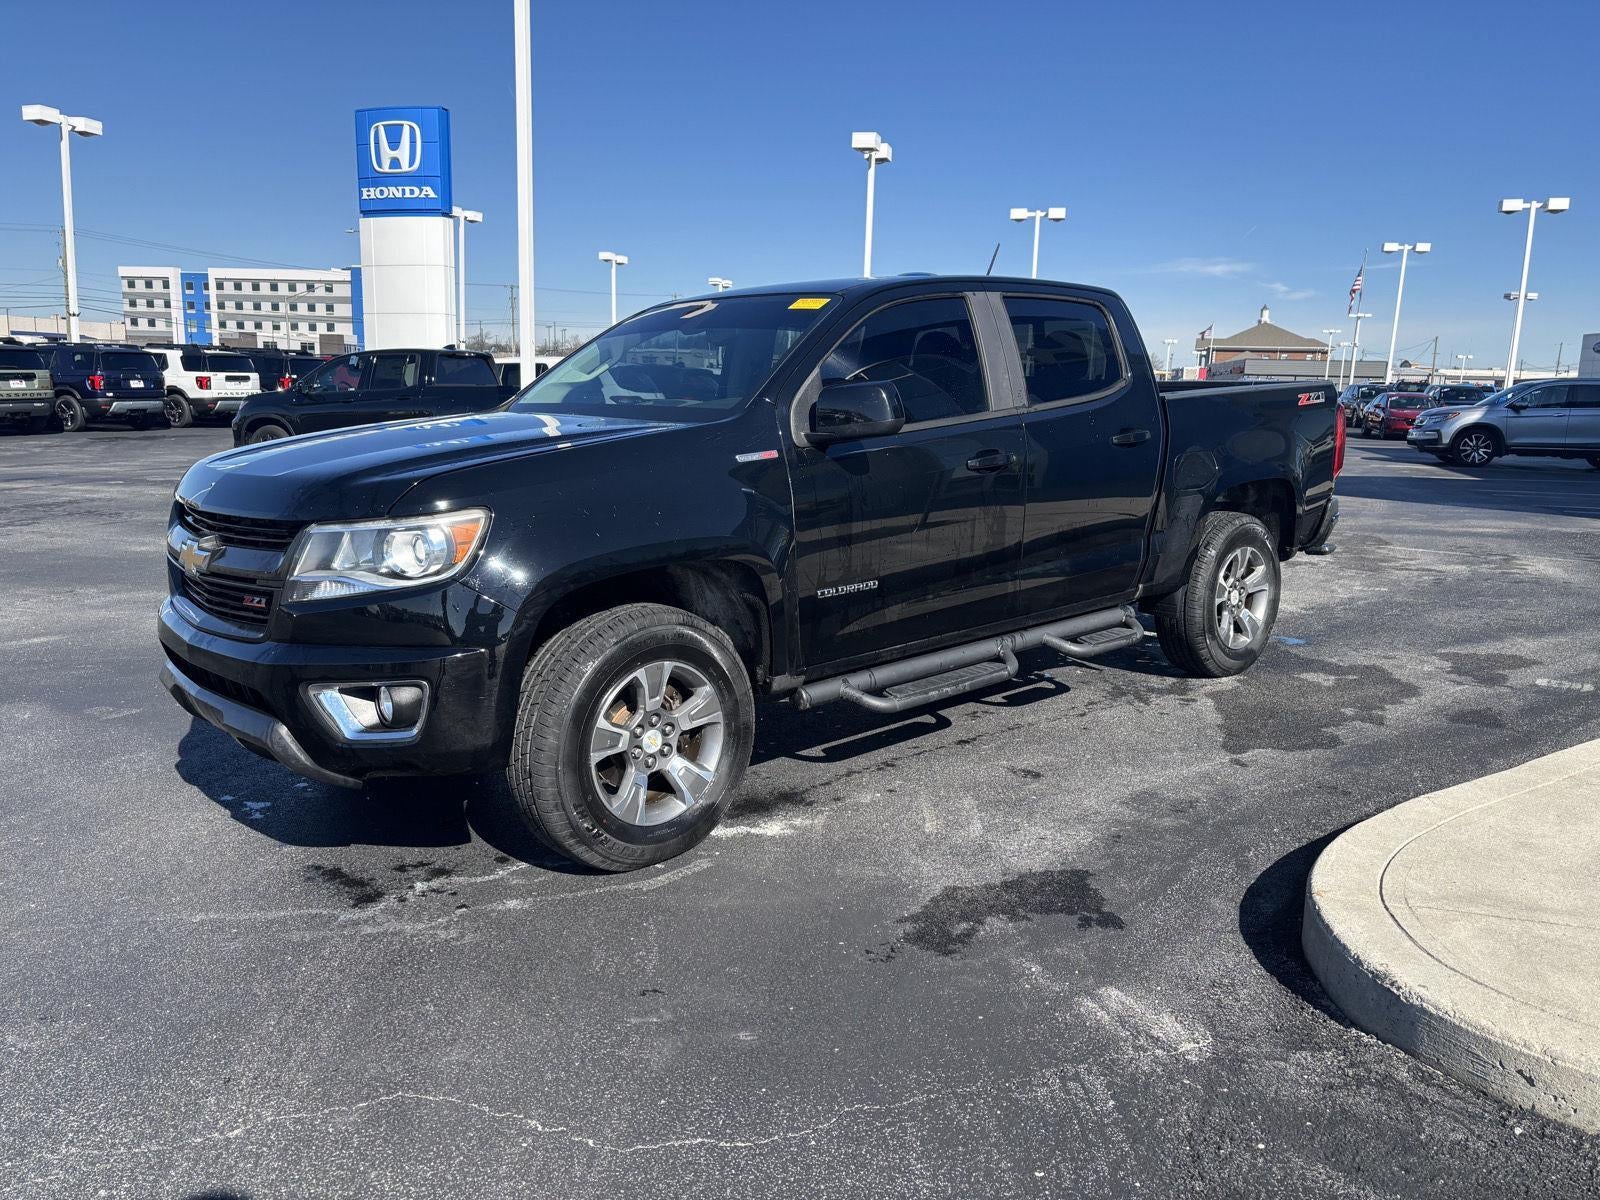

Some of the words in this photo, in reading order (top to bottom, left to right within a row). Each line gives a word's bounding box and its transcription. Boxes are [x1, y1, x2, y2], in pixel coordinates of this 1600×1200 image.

[360, 186, 438, 200] HONDA
[1297, 391, 1325, 406] Z71
[816, 580, 879, 599] COLORADO
[243, 595, 266, 608] Z71
